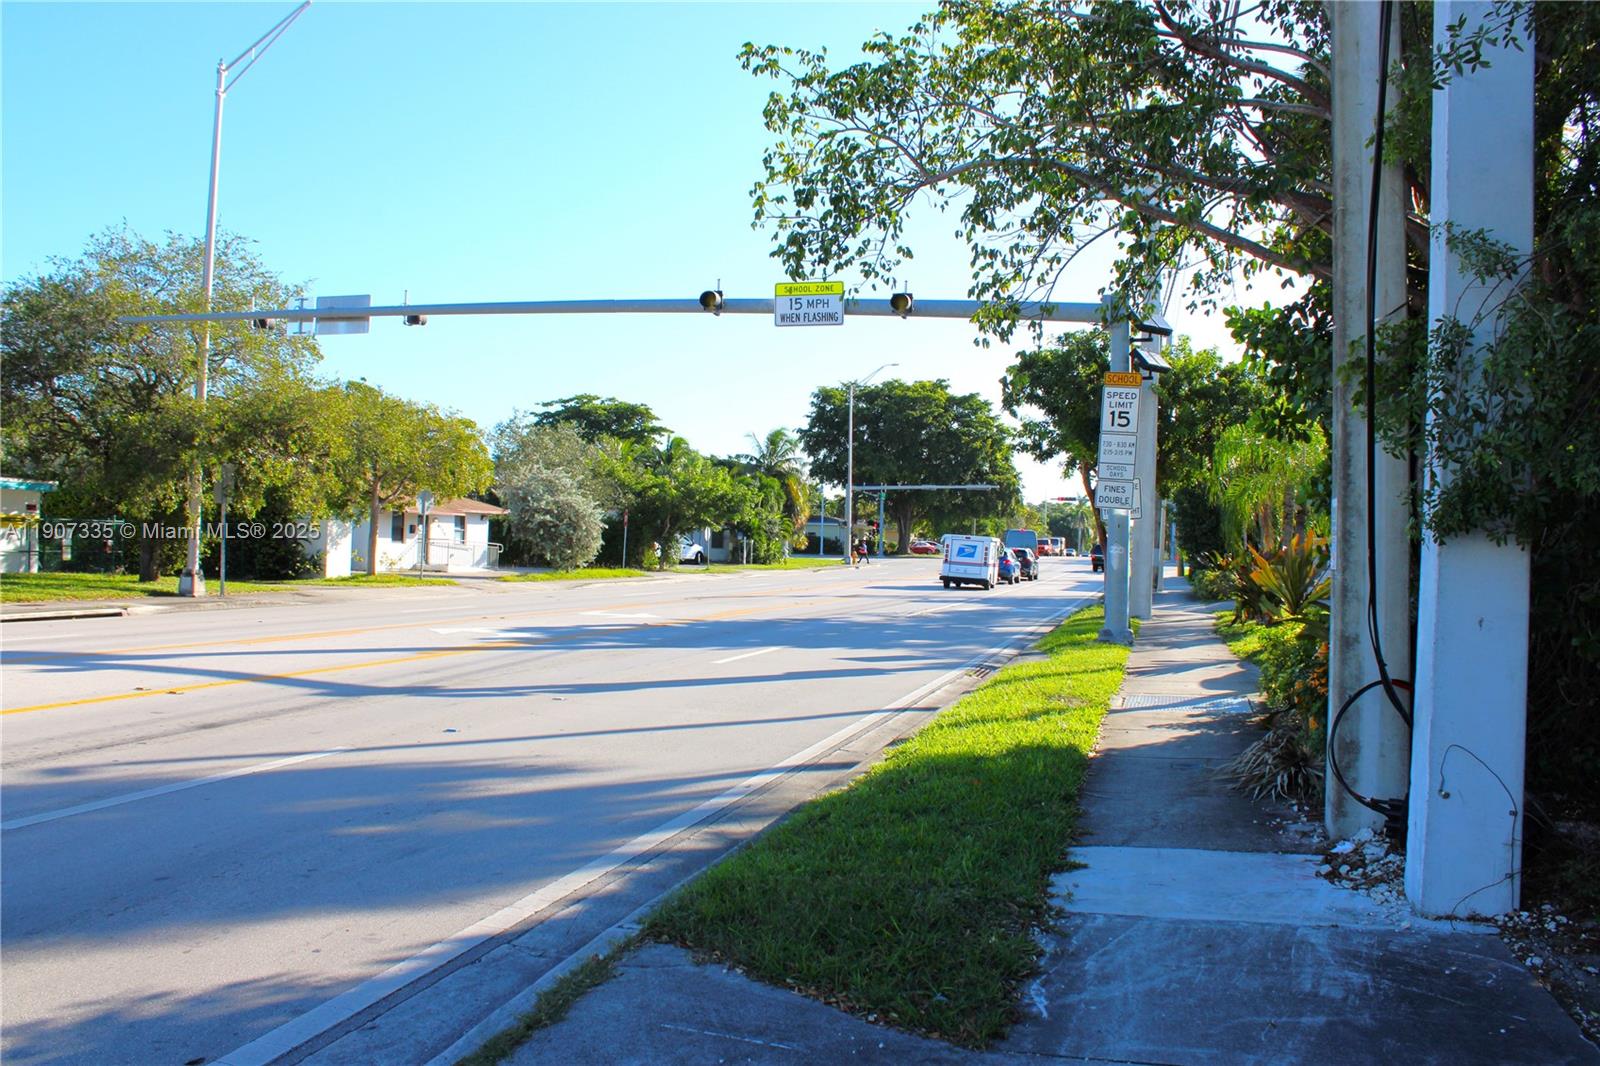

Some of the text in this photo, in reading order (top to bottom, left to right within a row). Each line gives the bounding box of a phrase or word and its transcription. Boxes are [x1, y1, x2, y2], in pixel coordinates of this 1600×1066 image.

[789, 298, 830, 311] 15 MPH
[780, 312, 839, 323] WHEN FLASHING
[1107, 374, 1139, 384] SCHOOL
[1106, 391, 1137, 400] SPEED
[1109, 401, 1134, 409] LIMIT
[1109, 410, 1131, 428] 15
[1104, 484, 1126, 493] FINES
[1098, 496, 1131, 505] DOUBLE
